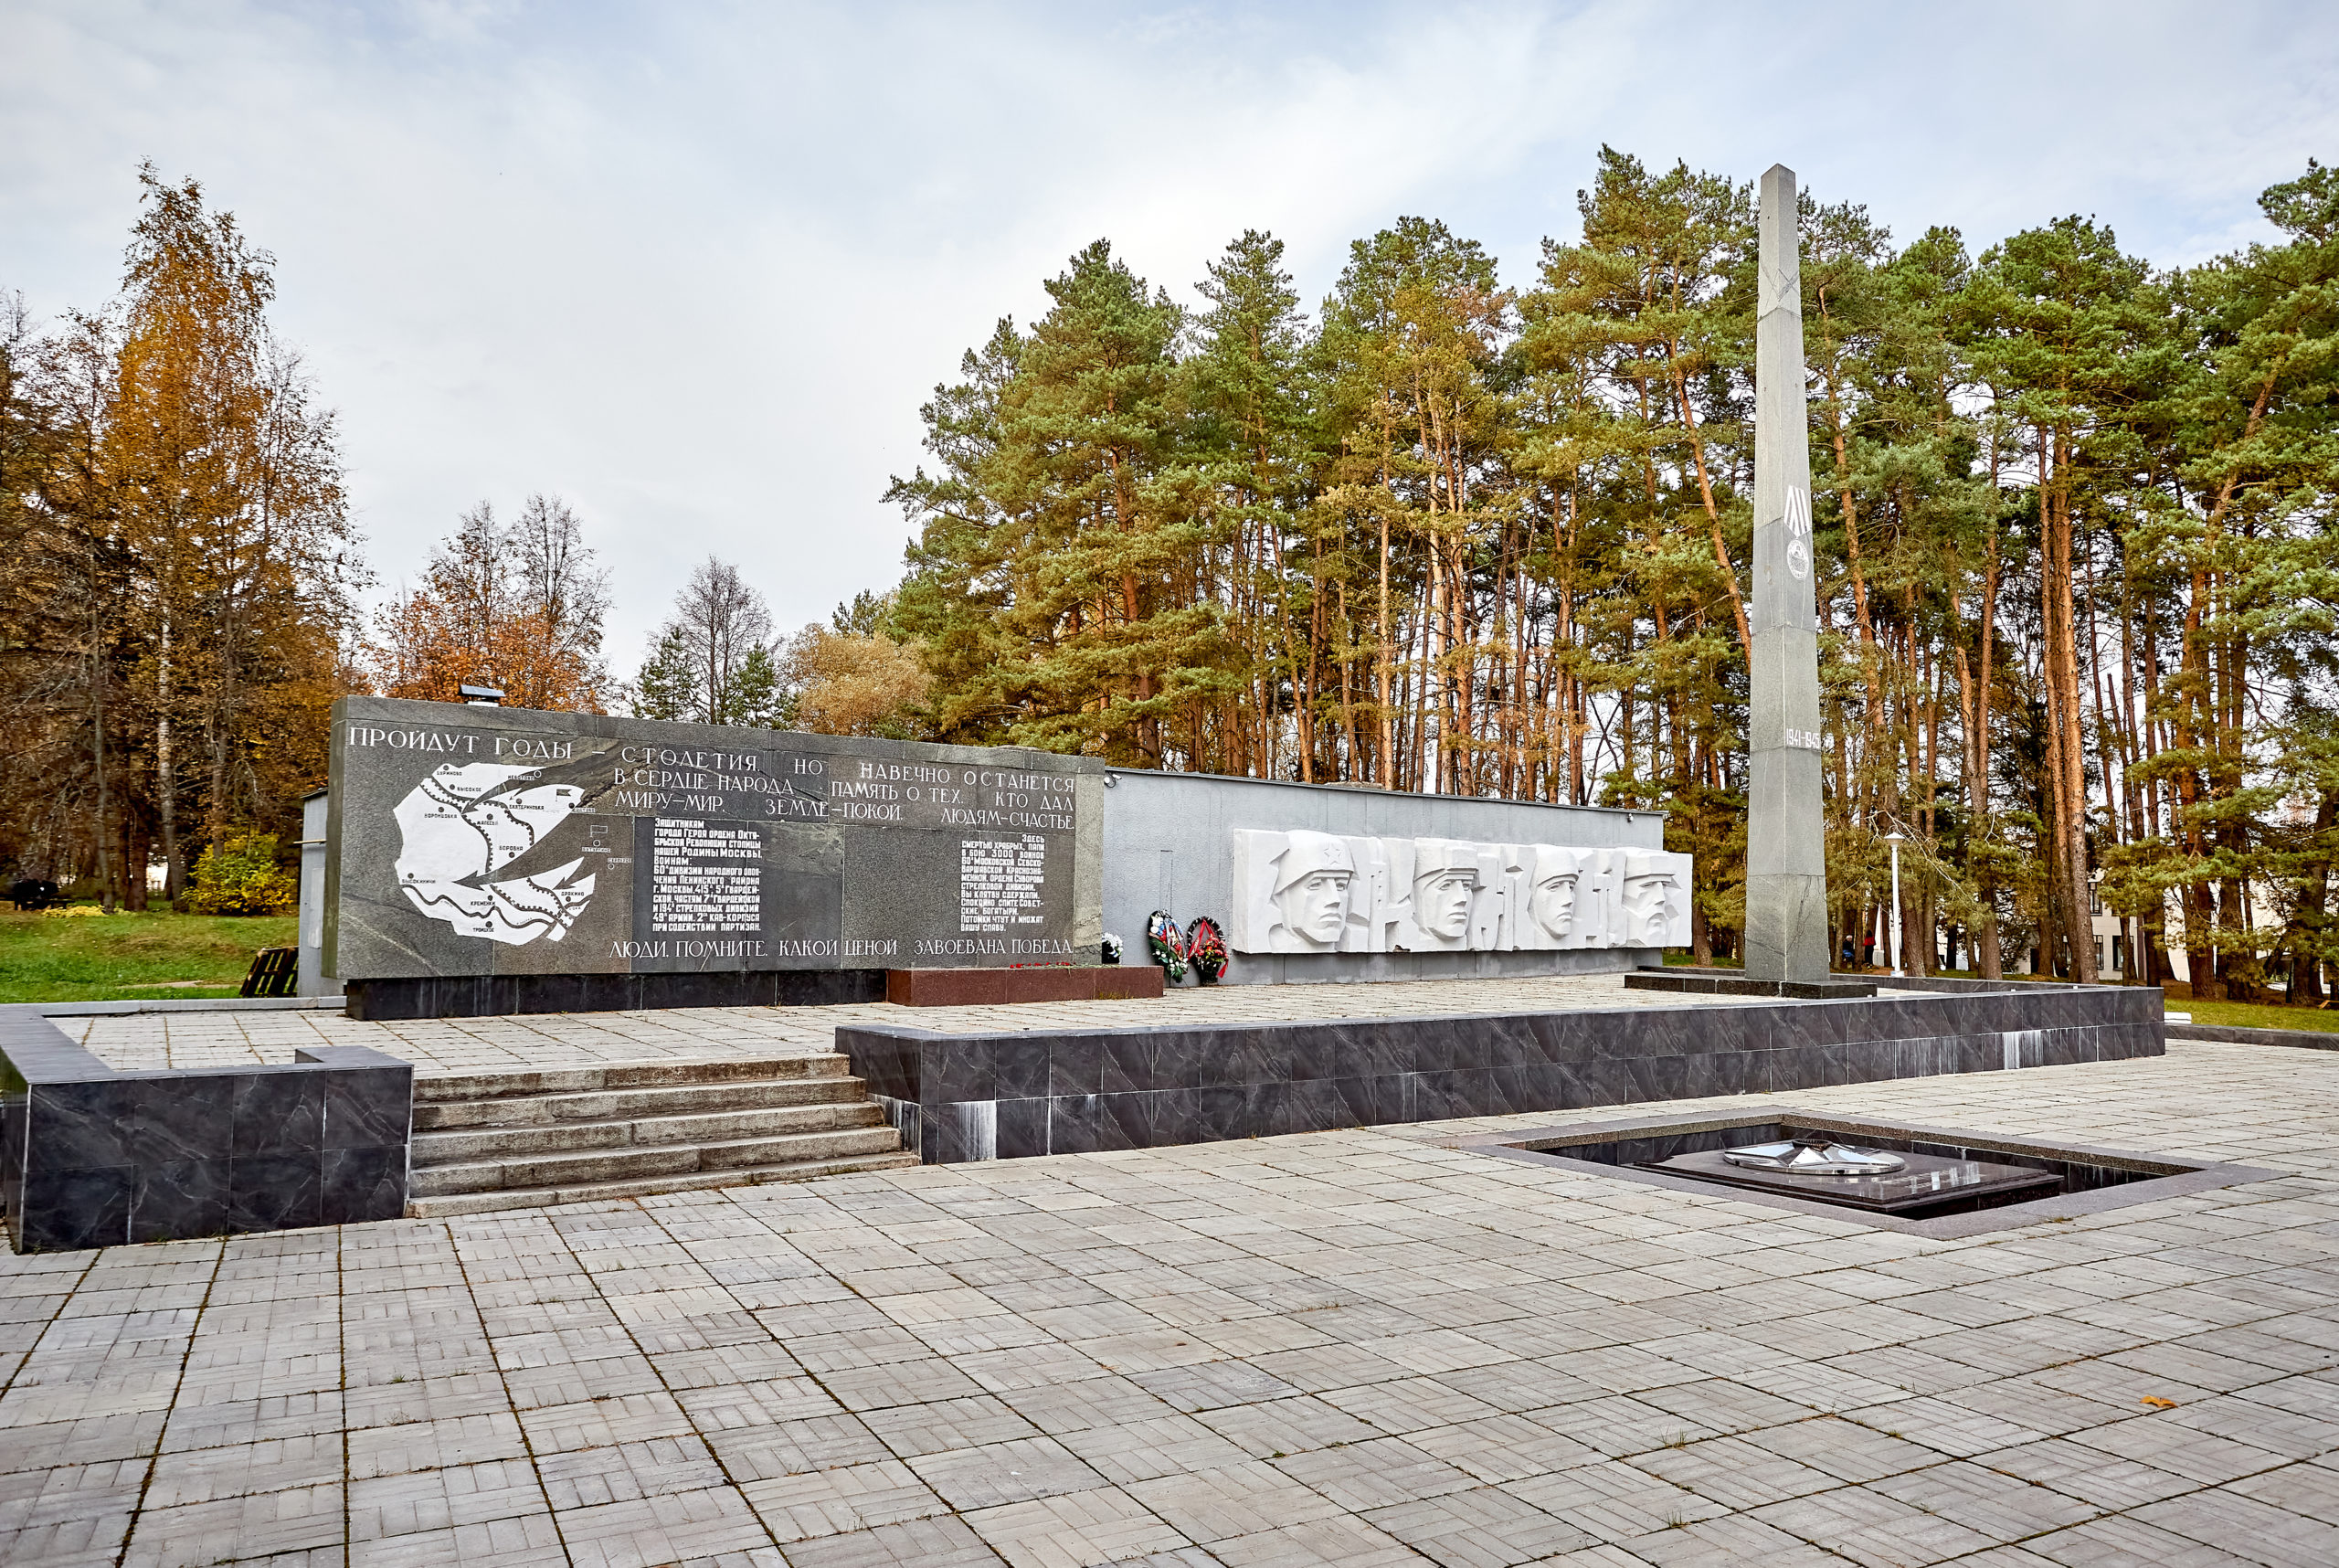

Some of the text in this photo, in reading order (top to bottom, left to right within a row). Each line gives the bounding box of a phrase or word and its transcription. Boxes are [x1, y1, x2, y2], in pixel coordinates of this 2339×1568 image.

[1786, 727, 1820, 749] 1941-1945
[349, 726, 480, 754] ПРОЙДУТ
[495, 736, 572, 759] ГОДЫ
[794, 758, 822, 775] НО
[860, 762, 950, 784] НАВЕЧНО
[964, 770, 1074, 793] ОСТАНЕТСЯ
[614, 768, 626, 785] В
[635, 769, 709, 790] СЕРДЦЕ
[718, 775, 796, 795] НАРОДА
[831, 781, 898, 800] ПАМЯТЬ
[906, 786, 920, 801] О
[995, 791, 1029, 809] КТО
[1040, 795, 1074, 811] ДАЛ
[655, 818, 704, 829] ЗАЩИТНИКАМ
[654, 828, 682, 837] ГОРОДА
[683, 829, 706, 838] ГЕРОЯ
[709, 830, 736, 839] ОРДЕНА
[1021, 834, 1045, 843] ЗДЕСЬ
[654, 837, 761, 849] БРЬСКОЙ РЕВОЛЮЦИИ СТОЛИЦЫ
[961, 841, 993, 849] СМЕРТЬЮ
[654, 846, 679, 856] НАШЕЙ
[682, 847, 718, 857] РОДИНЫ
[968, 849, 986, 857] БОЮ
[991, 849, 1014, 858] 3000
[1020, 851, 1044, 859] ВОИНОВ
[974, 857, 1015, 865] МОСКОВСКОЙ
[669, 866, 703, 875] ДИВИЗИИ
[704, 866, 743, 876] НАРОДНОГО
[961, 865, 1003, 874] ВАРШАВСКОЙ
[653, 875, 760, 885] ЧЕНИЯ ЛЕНИНСКОГО РАЙОНА
[990, 874, 1013, 883] ОРДЕНА
[1014, 874, 1044, 884] СУВОРОВА
[961, 882, 1003, 890] СТРЕЛКОВОЙ
[674, 895, 702, 904] ЧАСТЯМ
[713, 894, 760, 904] ГВАРДЕЙСКОЙ
[961, 890, 972, 898] ВЫ
[961, 898, 995, 906] СПОКОЙНО
[998, 899, 1019, 907] СПИТЕ
[652, 904, 658, 913] И
[676, 904, 723, 913] СТРЕЛКОВЫХ
[725, 904, 759, 913] ДИВИЗИЙ
[961, 915, 1044, 924] ПОТОМКИ ЧТУТ И МНОЖАТ
[652, 923, 668, 932] ПРИ
[668, 923, 716, 932] СОДЕЙСТВИИ
[961, 924, 979, 932] ВАШУ
[778, 938, 838, 957] КАКОЙ
[844, 938, 897, 956] ЦЕНОЙ
[914, 938, 1005, 955] ЗАВОЕВАНА
